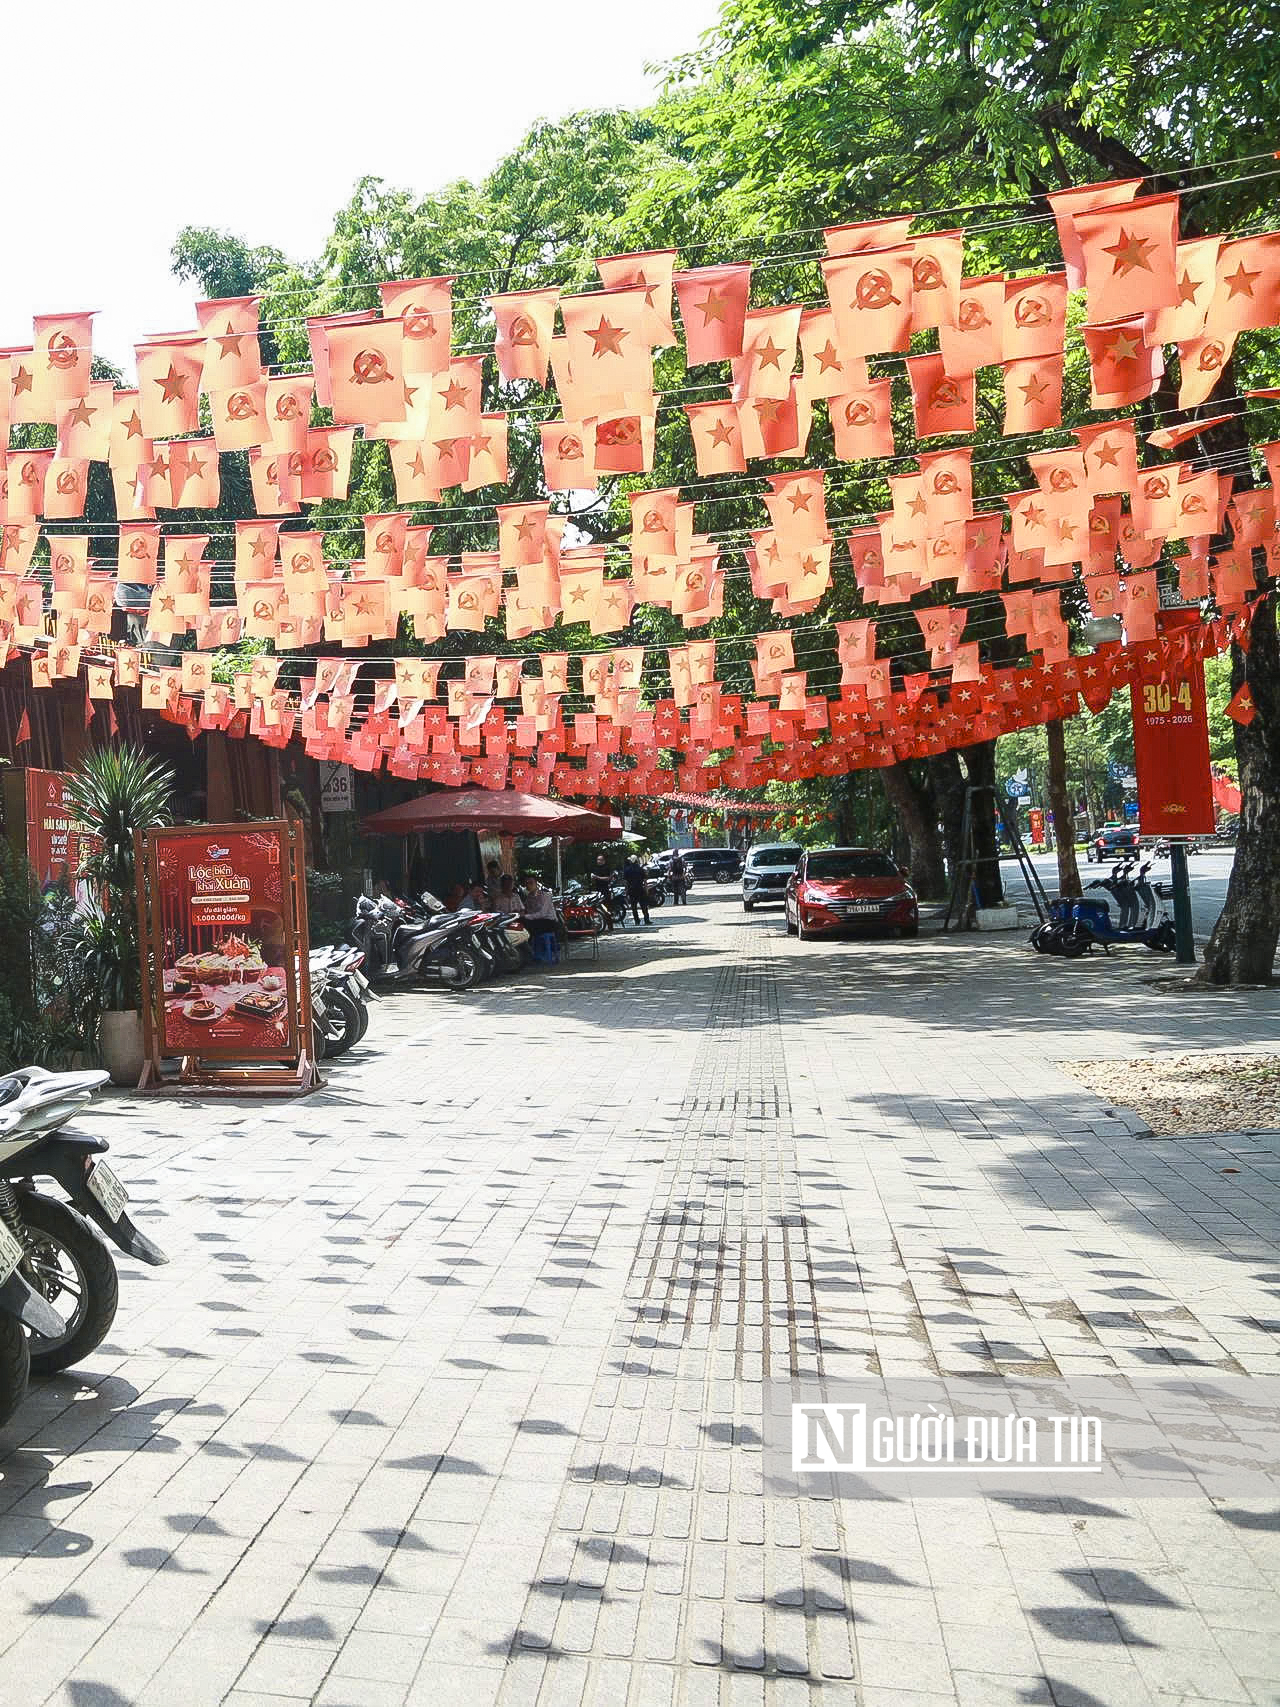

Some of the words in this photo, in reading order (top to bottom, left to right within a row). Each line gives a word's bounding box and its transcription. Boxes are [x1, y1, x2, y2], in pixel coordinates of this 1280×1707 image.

[1145, 716, 1166, 726] 1975
[190, 866, 212, 881] Lộc
[215, 875, 249, 890] Xuân
